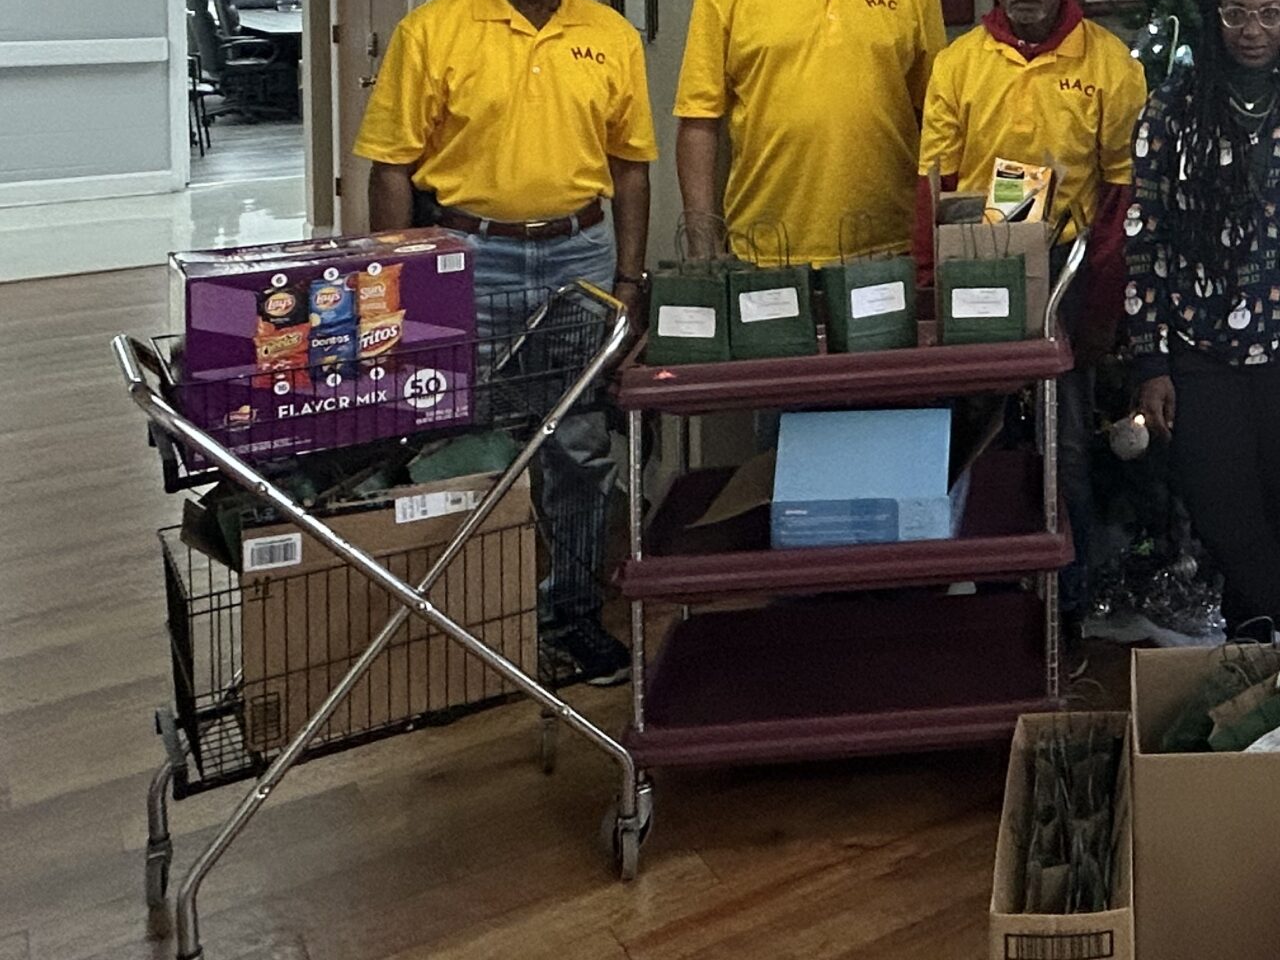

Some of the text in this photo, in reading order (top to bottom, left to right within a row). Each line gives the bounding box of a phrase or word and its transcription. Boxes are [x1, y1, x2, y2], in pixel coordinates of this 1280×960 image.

[570, 46, 606, 65] HAC
[1059, 78, 1096, 97] HAC
[312, 334, 350, 348] Doritos
[411, 377, 441, 398] 50
[278, 390, 388, 419] FLAVOR MIX
